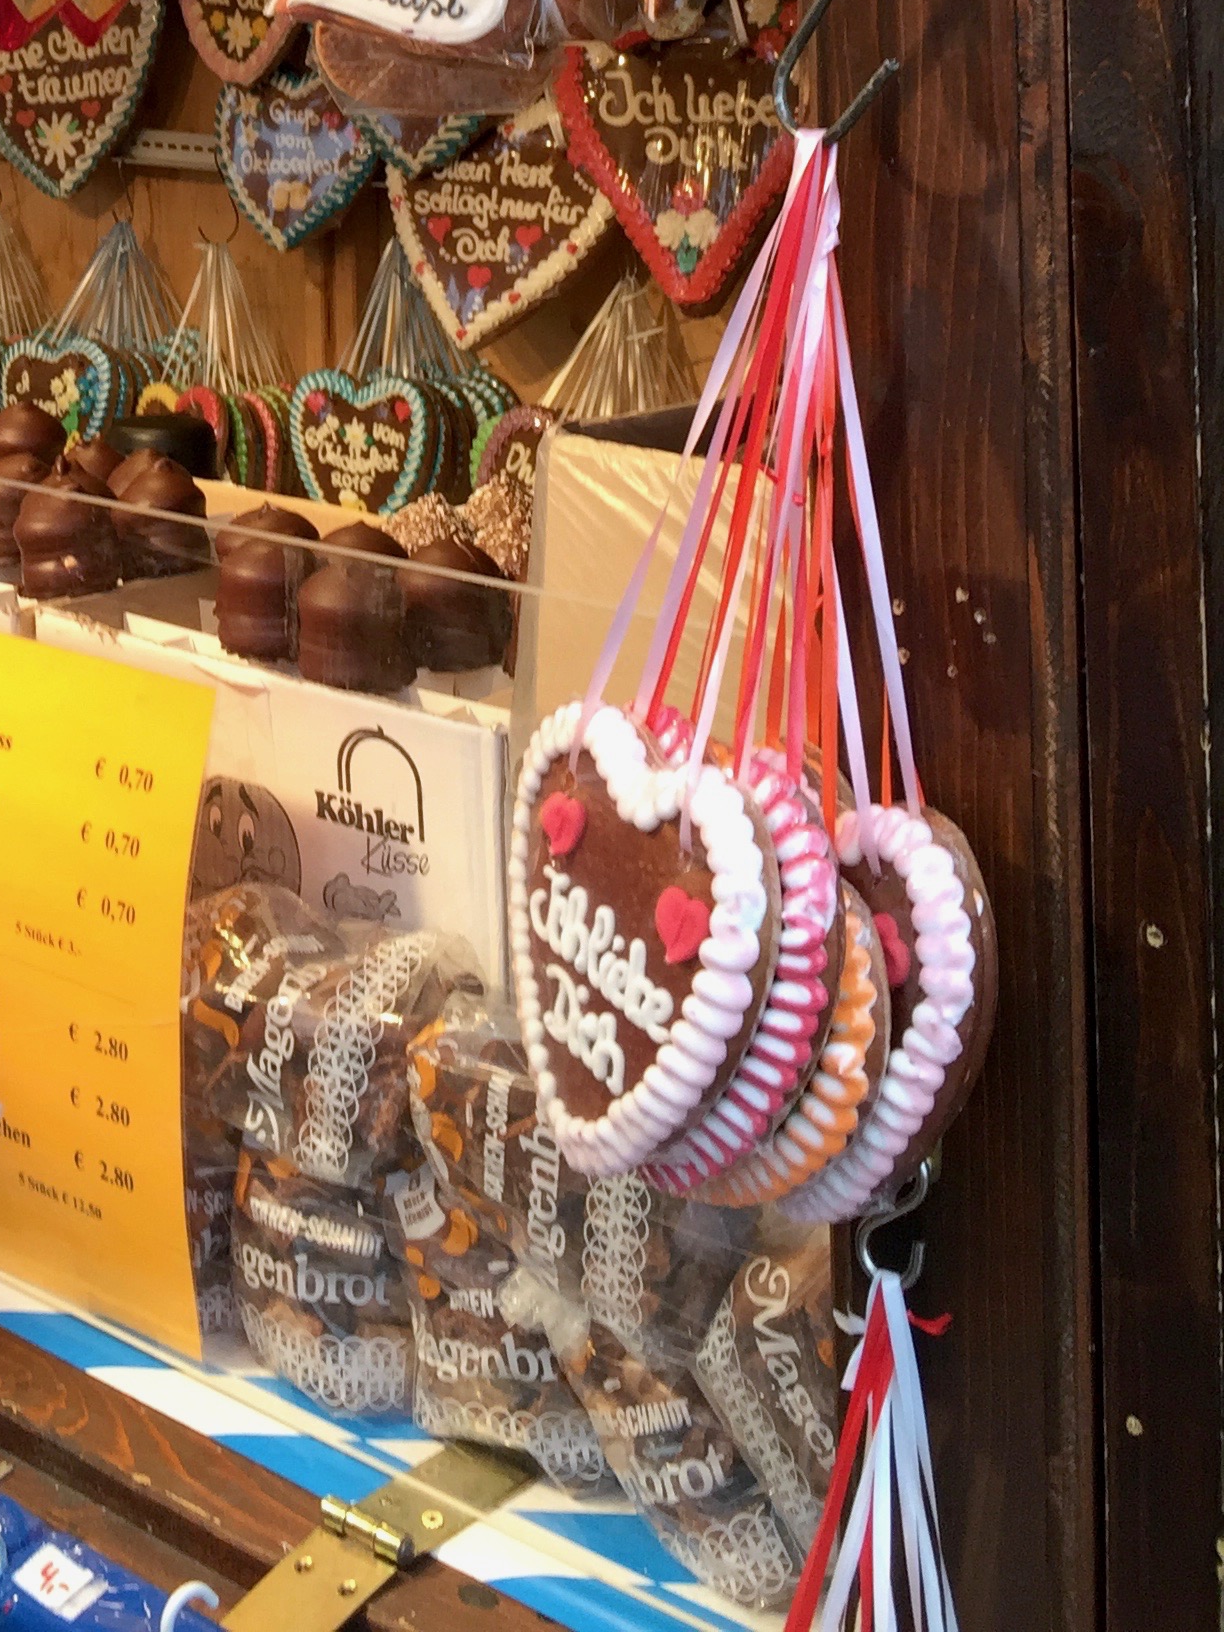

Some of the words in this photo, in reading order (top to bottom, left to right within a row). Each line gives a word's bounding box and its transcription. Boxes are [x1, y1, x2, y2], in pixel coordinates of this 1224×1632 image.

[599, 70, 682, 126] Ich
[684, 73, 780, 127] liebe
[452, 226, 511, 264] Dich
[119, 764, 154, 793] 0,70
[315, 789, 415, 845] Köhler
[105, 828, 140, 859] 0,70
[361, 834, 430, 878] Küsse
[101, 896, 136, 926] 0,70
